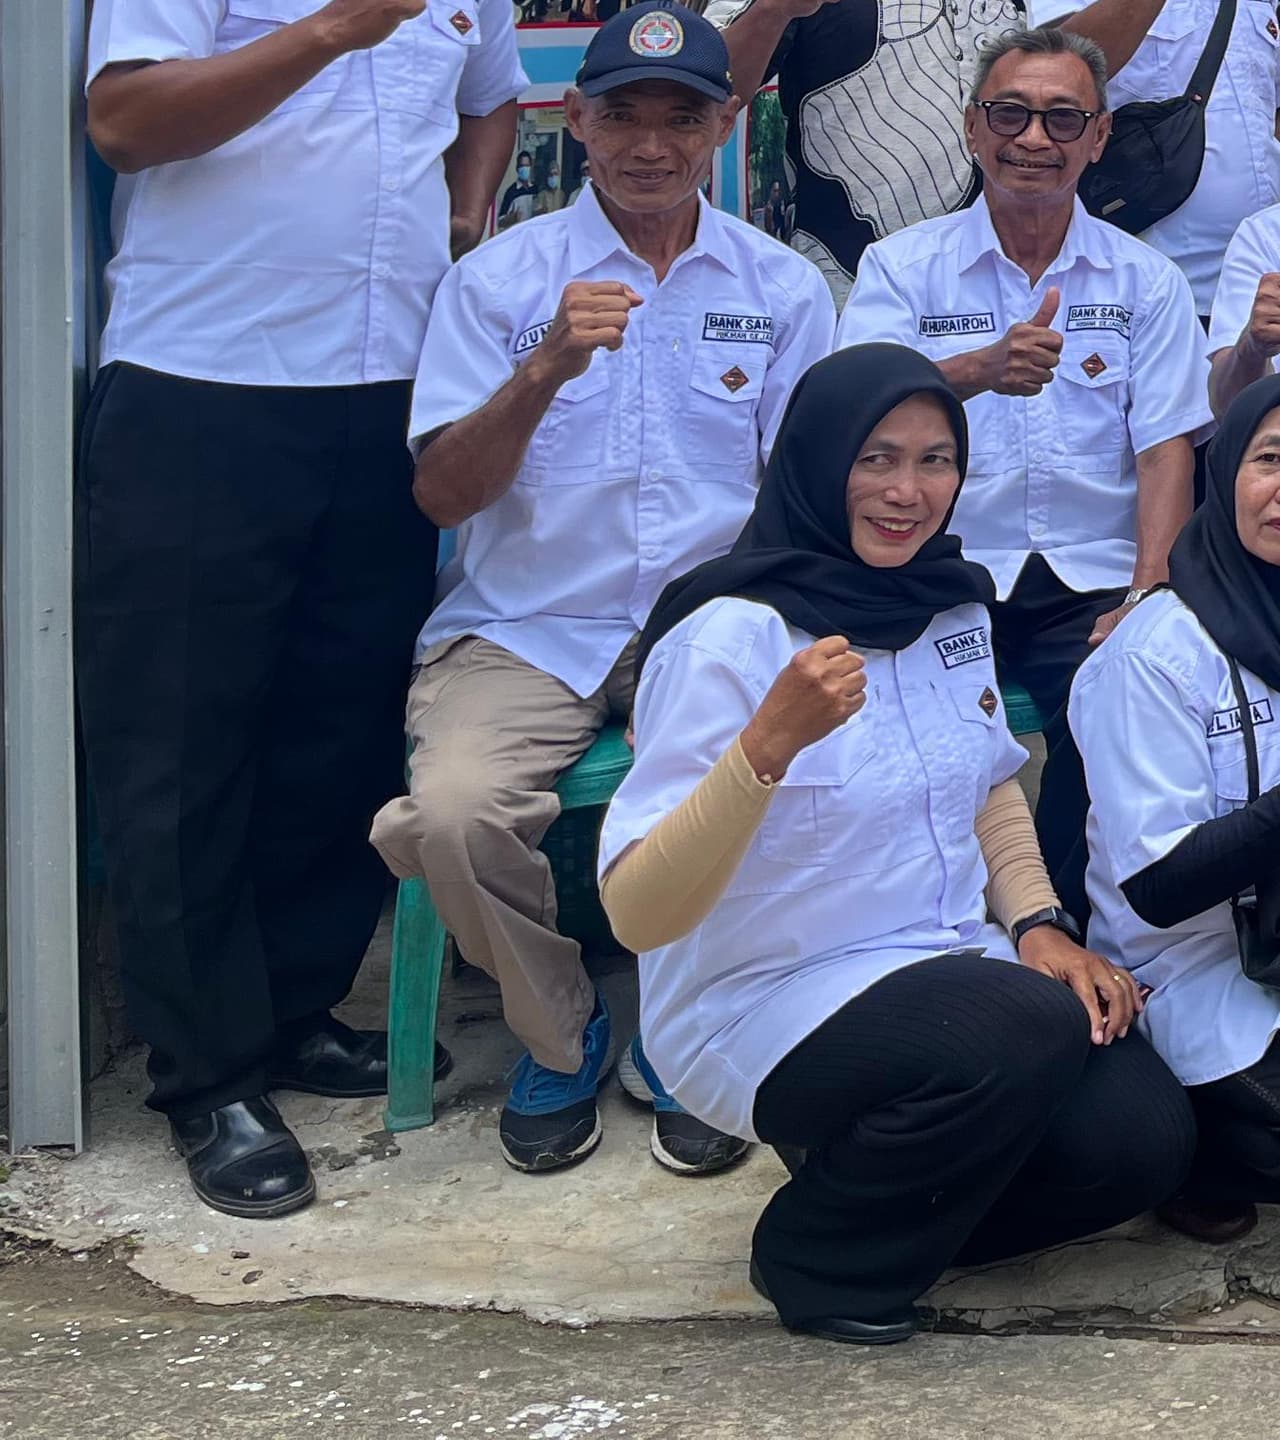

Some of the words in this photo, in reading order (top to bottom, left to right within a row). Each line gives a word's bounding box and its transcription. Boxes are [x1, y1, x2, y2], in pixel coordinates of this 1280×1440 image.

[1071, 307, 1097, 318] BANK
[709, 316, 743, 330] BANK
[744, 318, 773, 331] SAM
[942, 633, 980, 654] BANK
